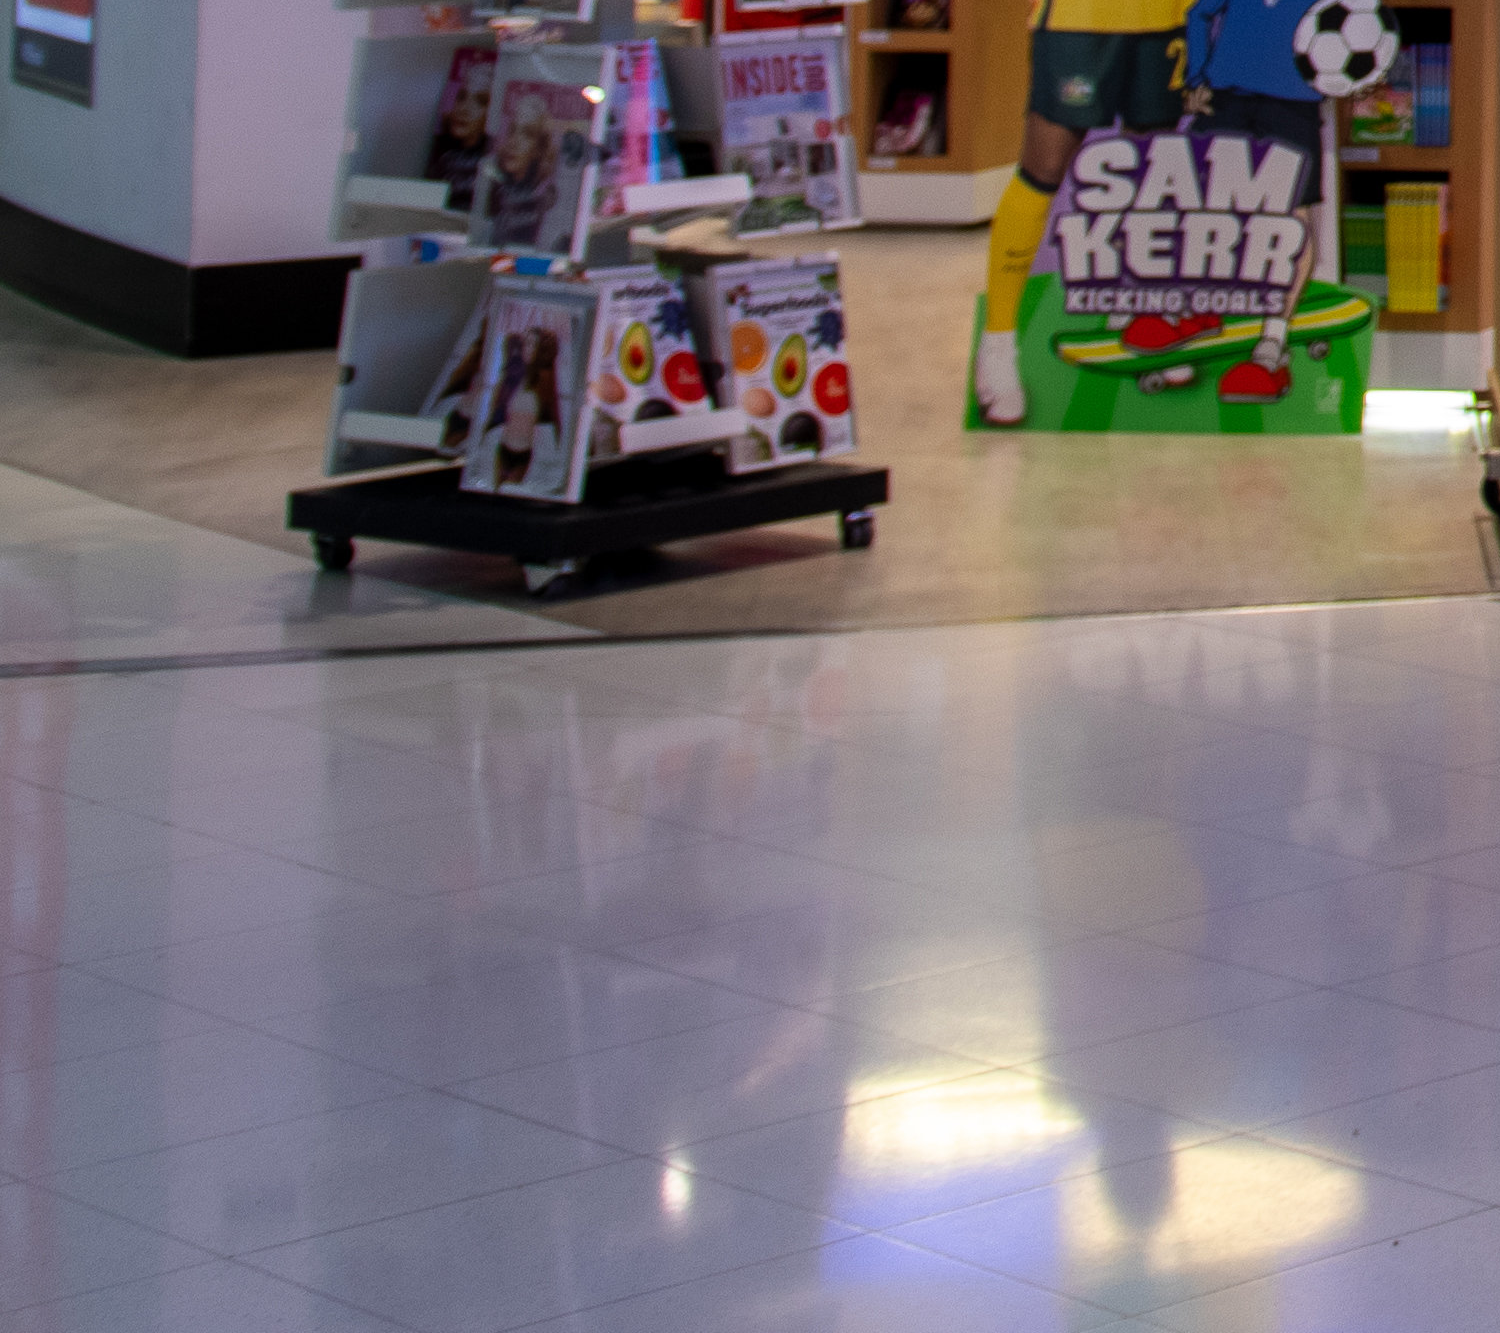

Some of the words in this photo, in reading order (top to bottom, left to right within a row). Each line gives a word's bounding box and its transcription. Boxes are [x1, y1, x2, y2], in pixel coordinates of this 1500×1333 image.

[723, 51, 802, 98] INSIDE
[1073, 135, 1304, 214] SAM
[1056, 210, 1305, 287] KERR
[1066, 287, 1185, 313] KICKING
[1191, 288, 1286, 314] GOALS
